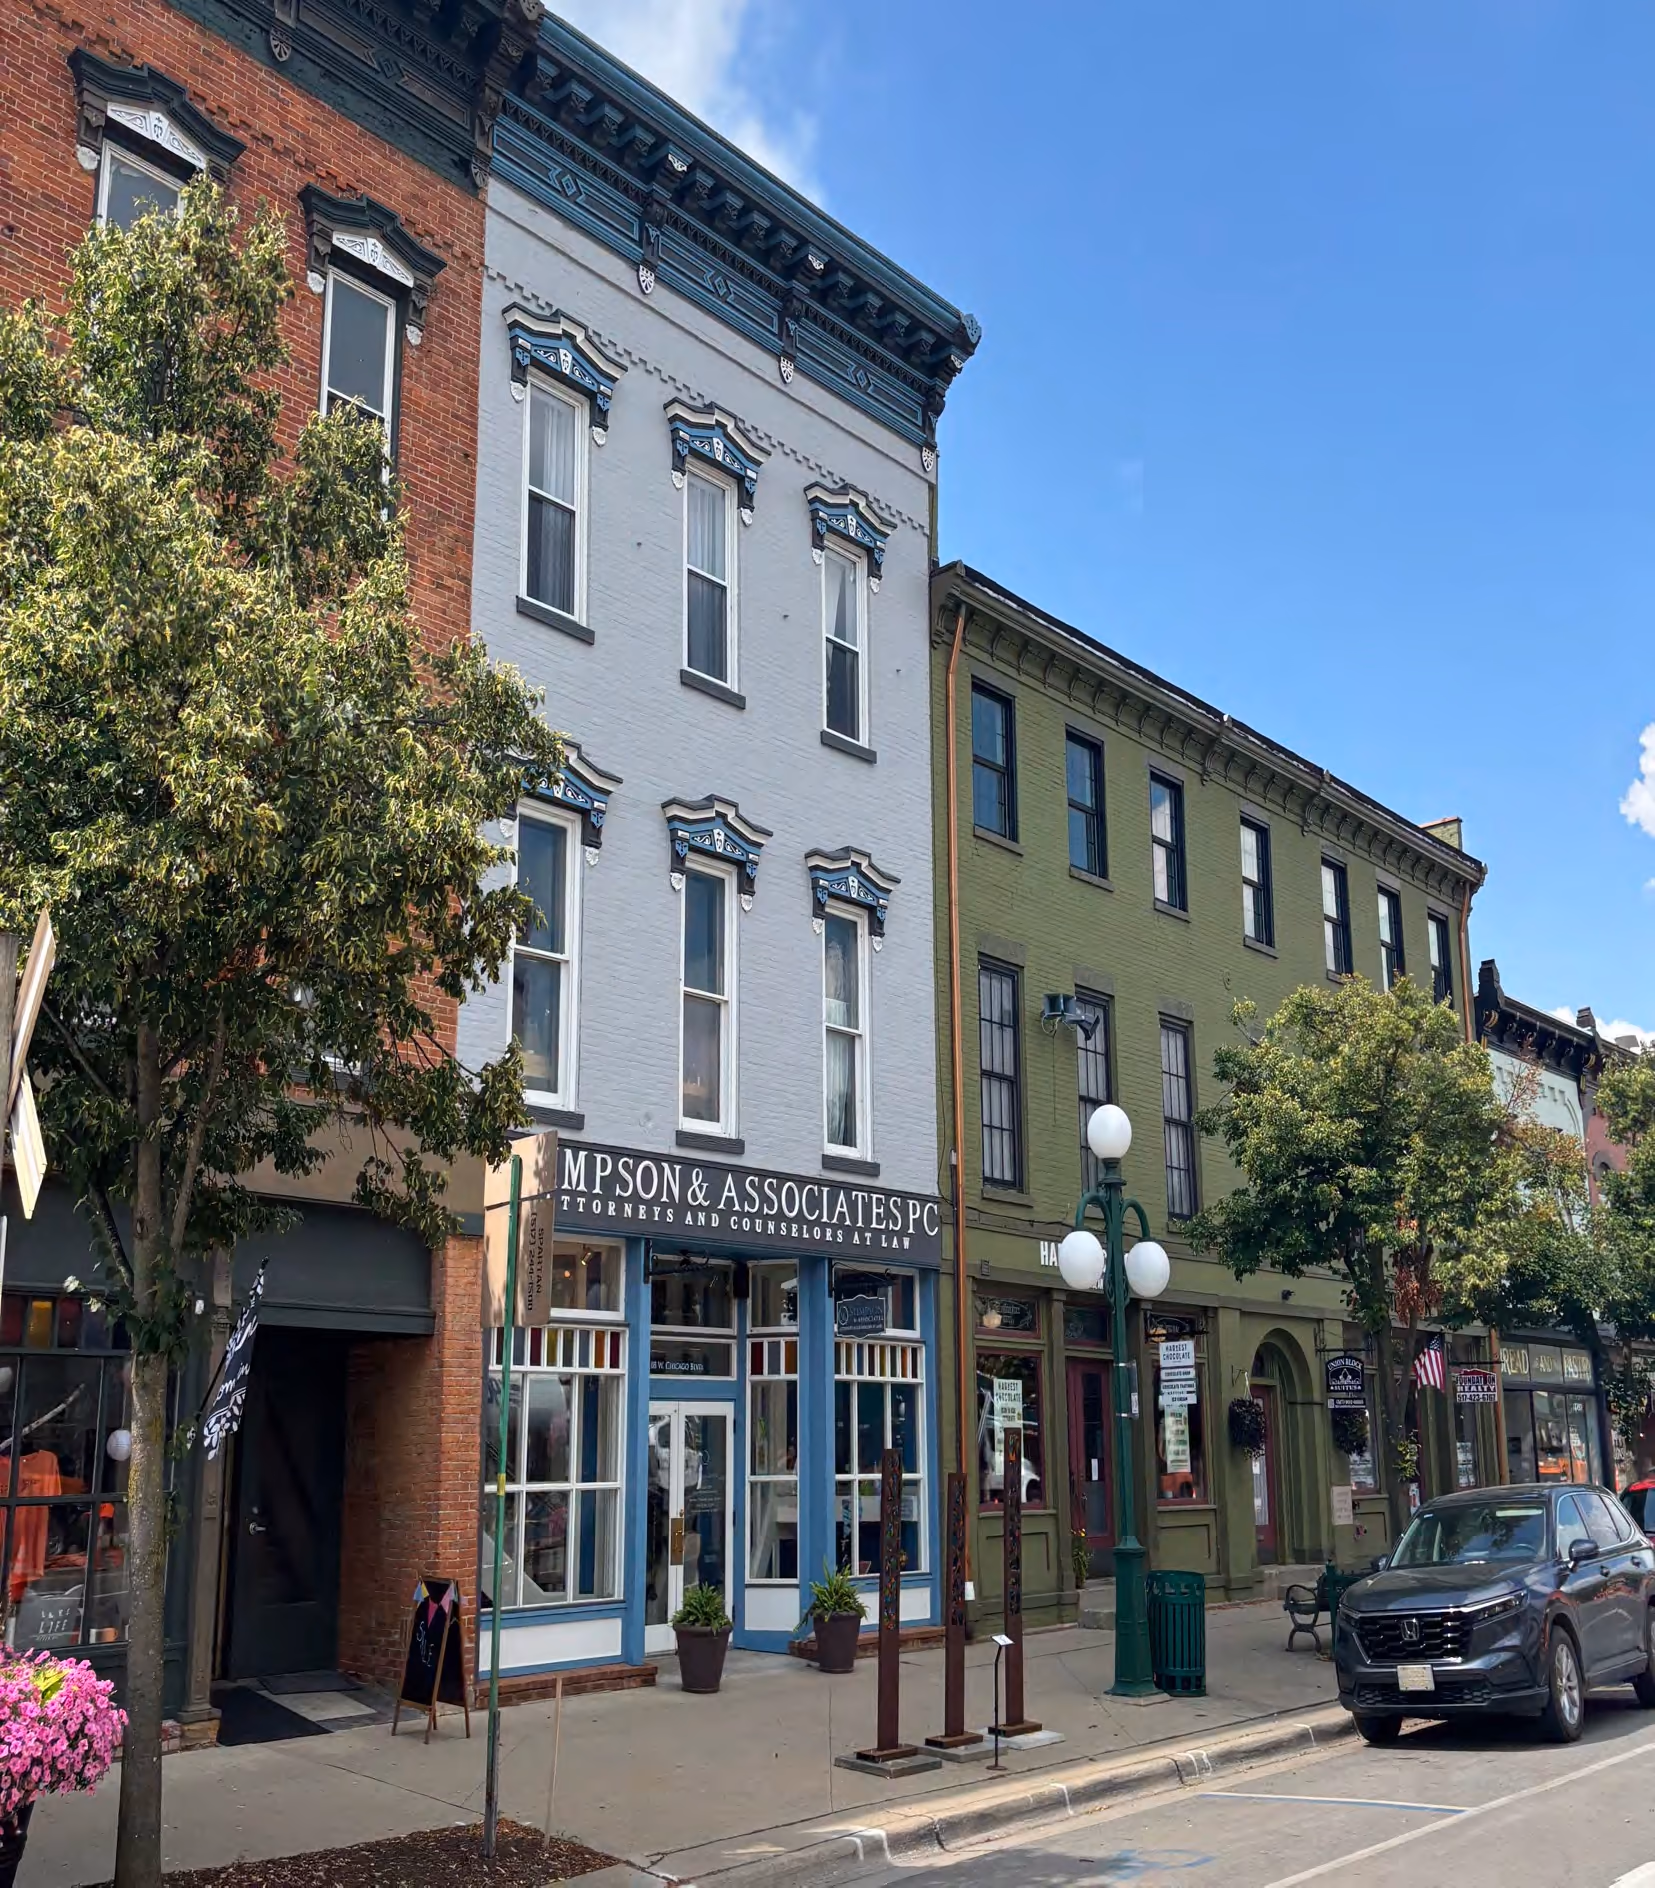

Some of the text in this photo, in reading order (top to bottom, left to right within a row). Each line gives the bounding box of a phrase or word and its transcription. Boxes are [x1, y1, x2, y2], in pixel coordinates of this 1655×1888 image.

[556, 1148, 938, 1236] MPSON & ASSOCIATES PC
[560, 1195, 910, 1250] TTORNEYS AND COUNSELORS AT LAW
[1327, 1358, 1362, 1370] UNION BLOCK
